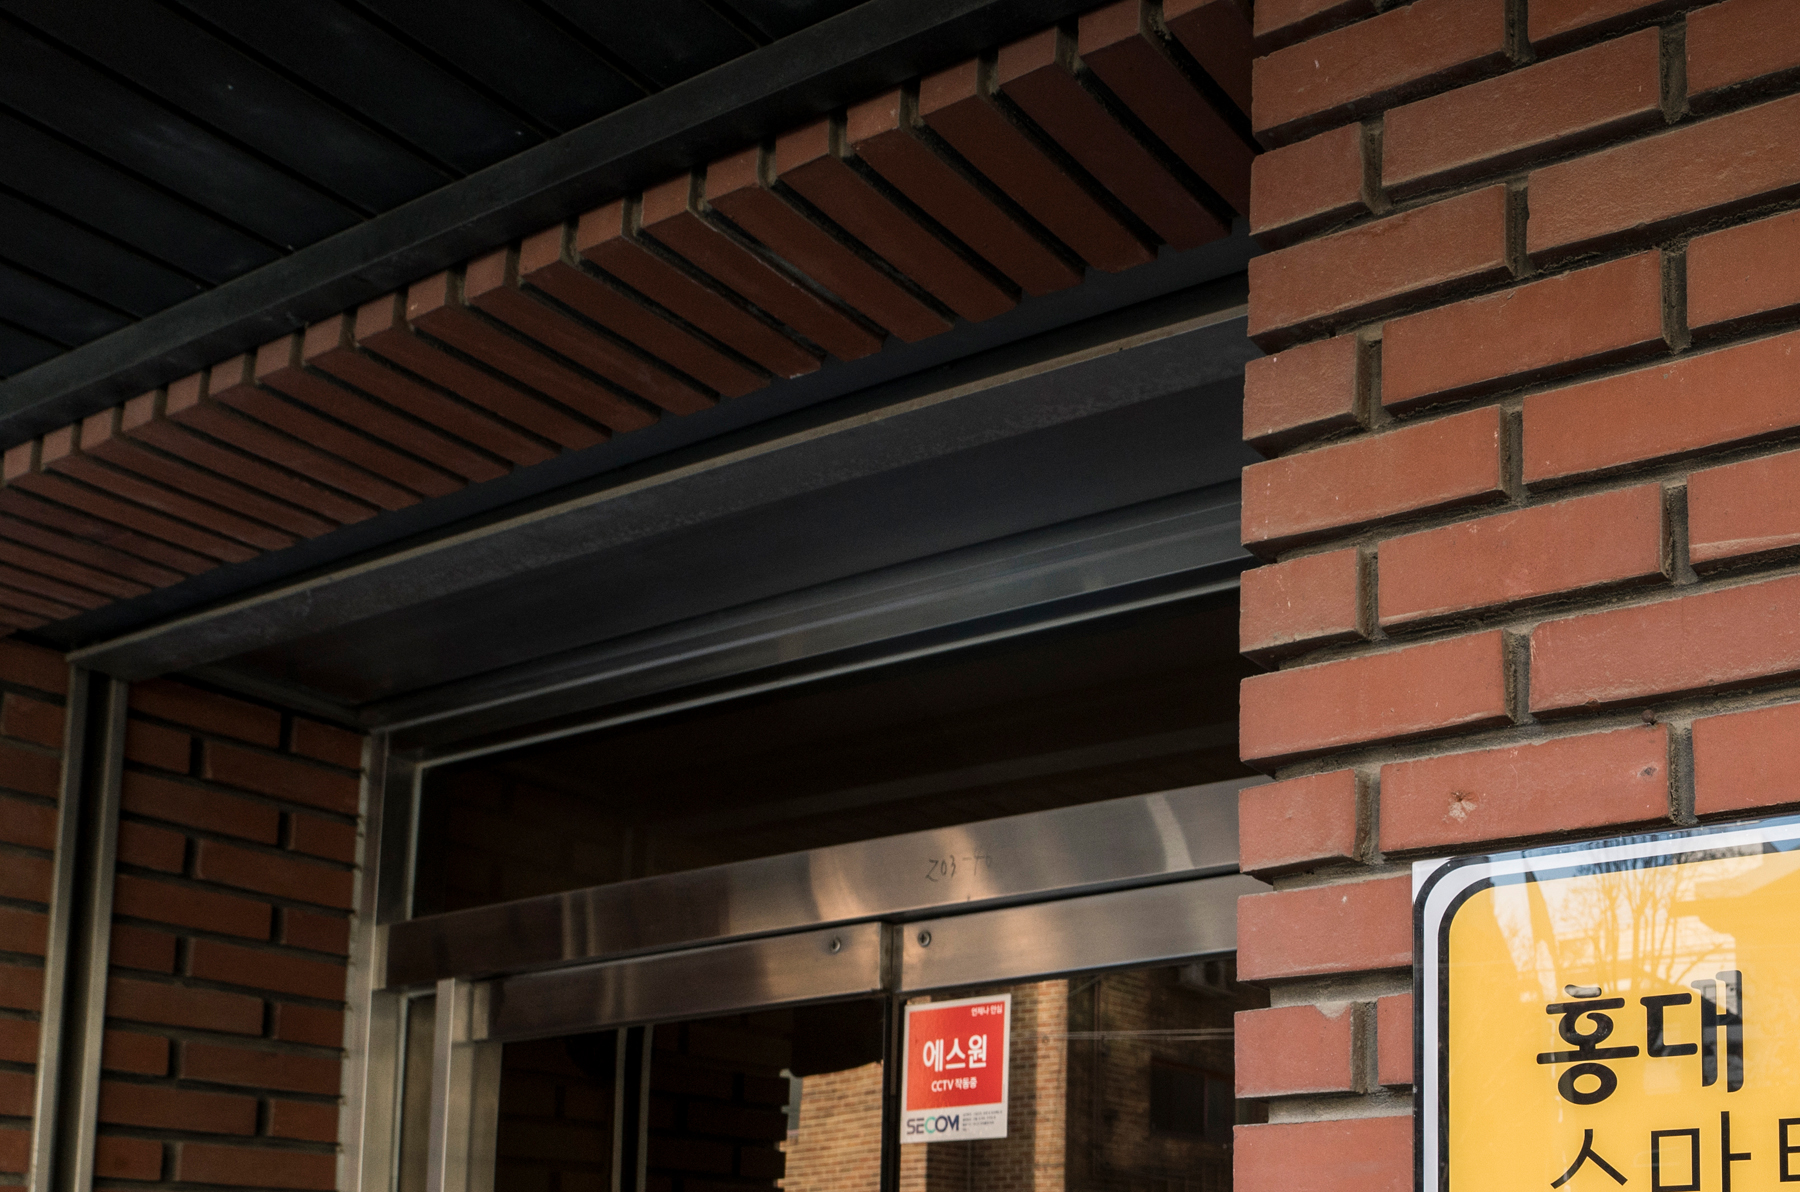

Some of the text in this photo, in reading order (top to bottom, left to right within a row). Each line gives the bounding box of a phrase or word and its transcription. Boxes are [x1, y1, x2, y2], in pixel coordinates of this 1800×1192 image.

[970, 1005, 990, 1018] 언제나
[1536, 970, 1745, 1106] 홍대
[922, 1033, 988, 1073] 에스원
[931, 1076, 978, 1093] CCTV 작동중
[906, 1113, 960, 1135] SECOM
